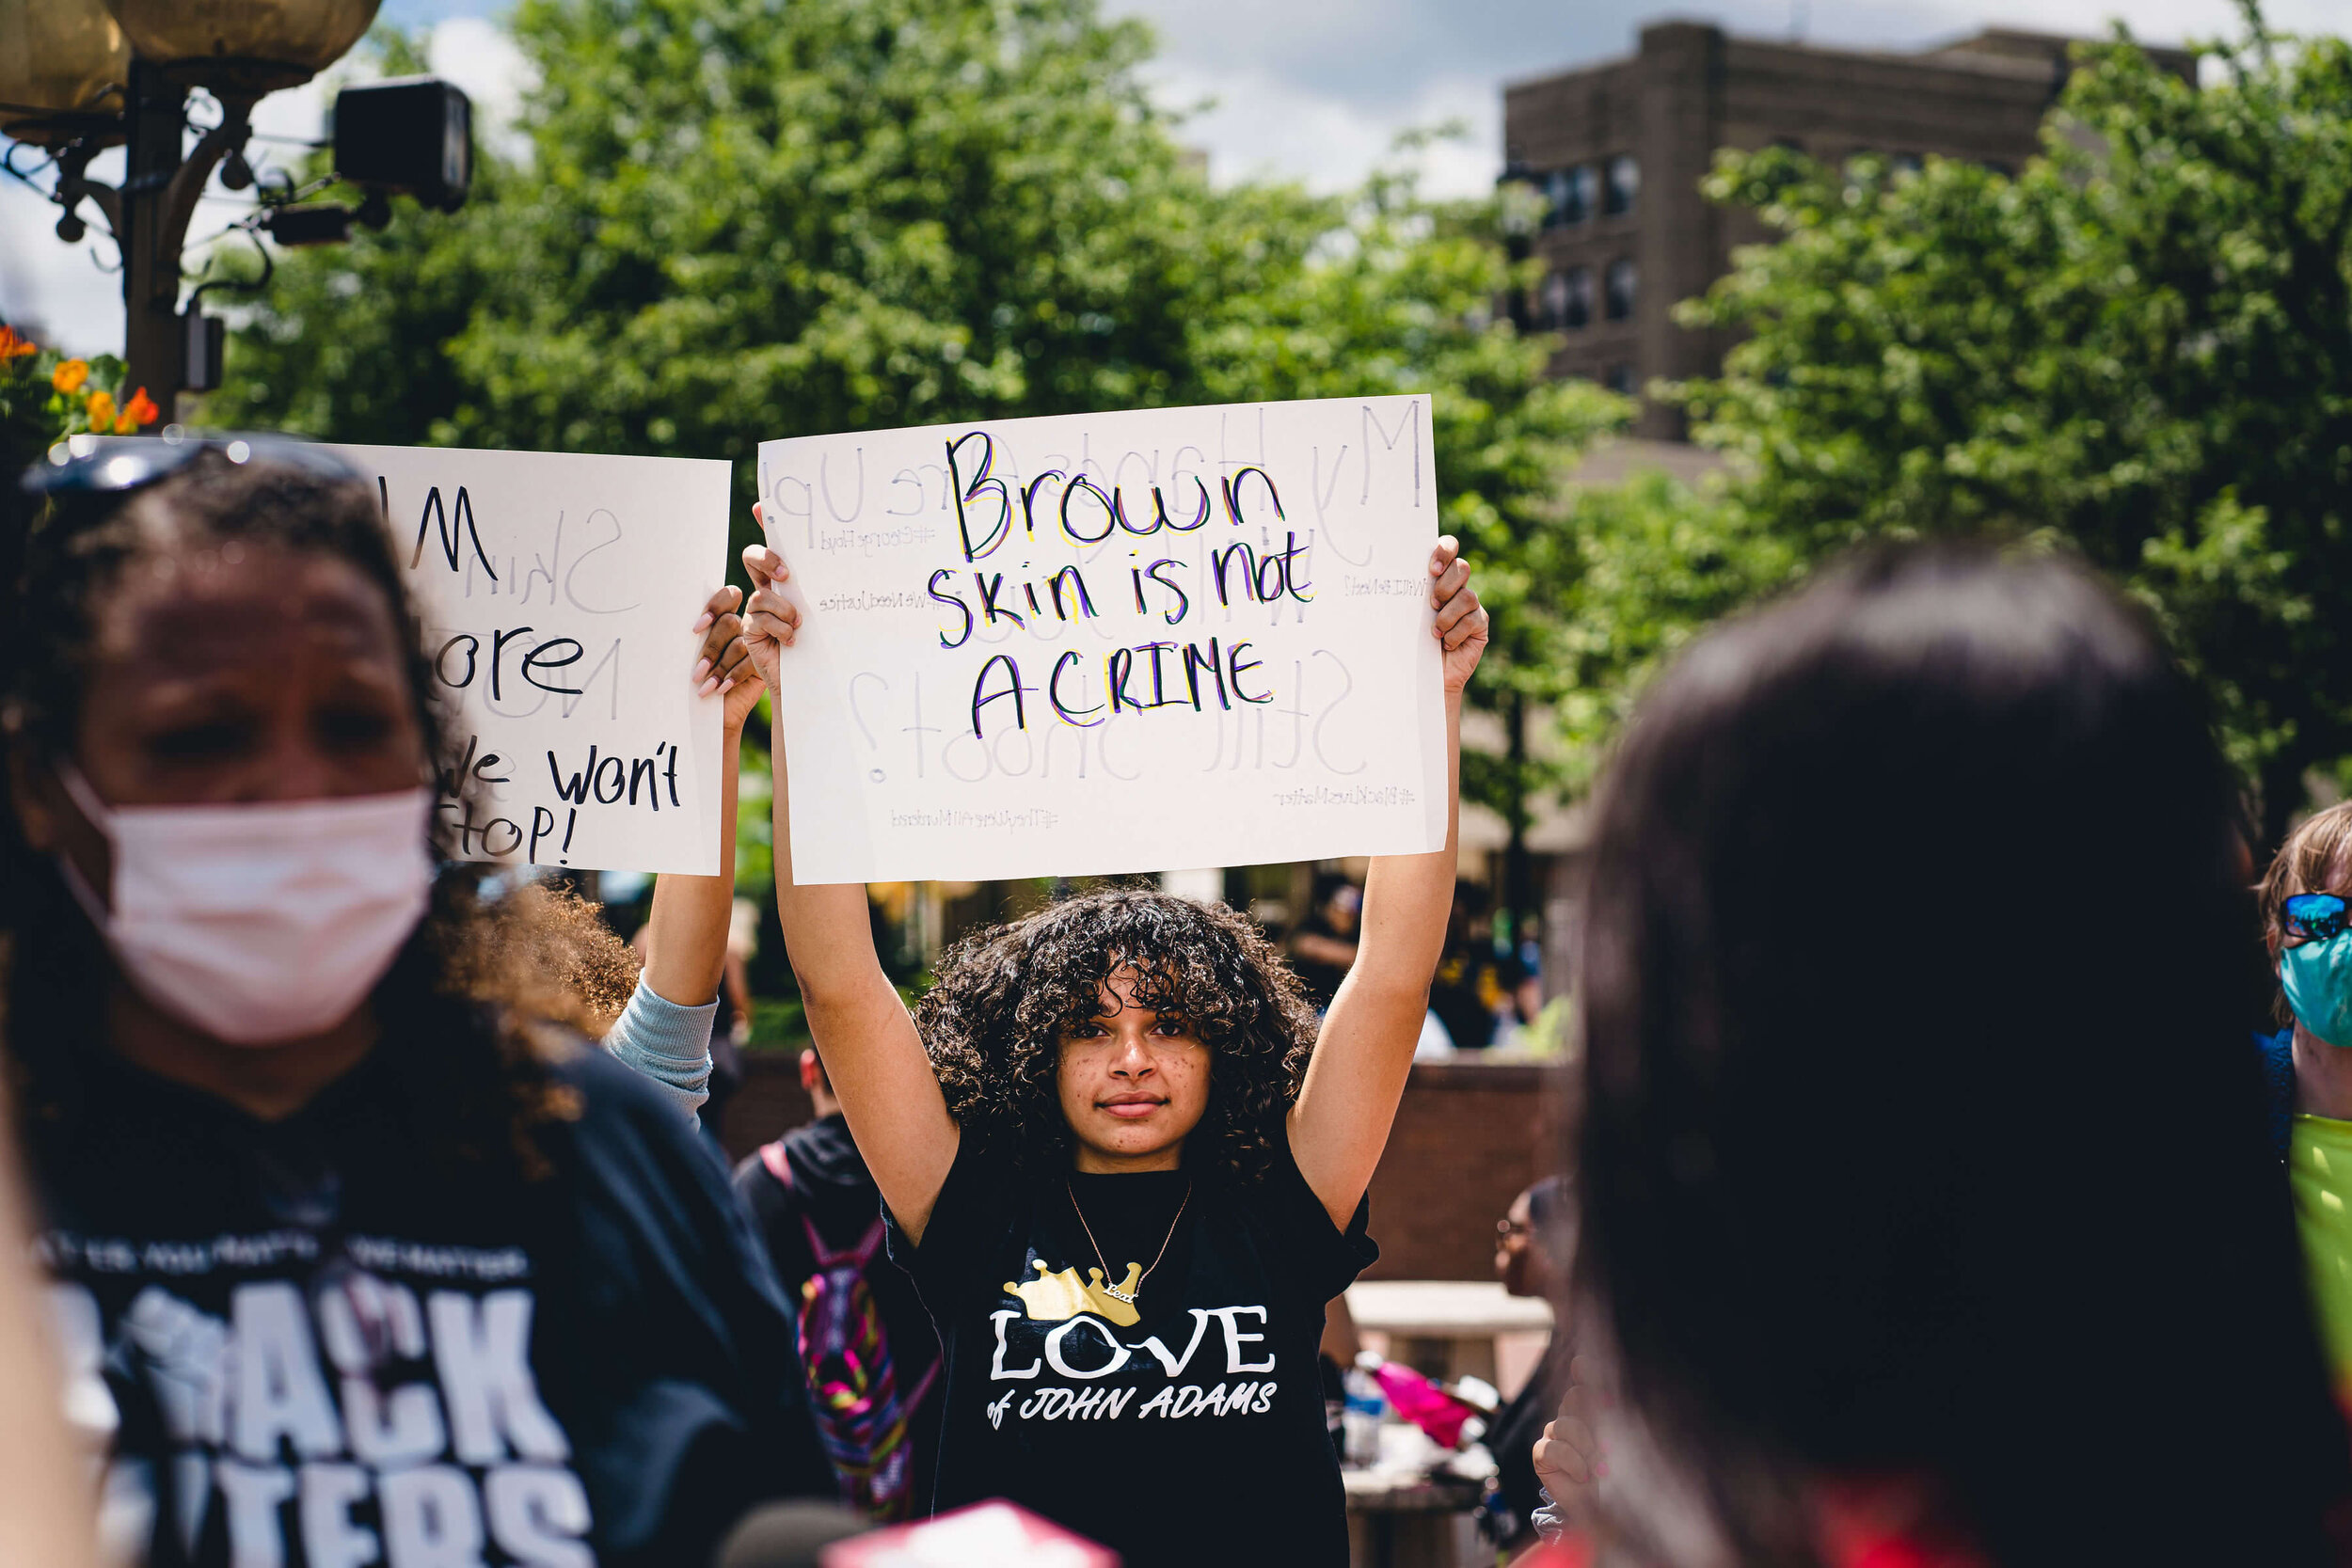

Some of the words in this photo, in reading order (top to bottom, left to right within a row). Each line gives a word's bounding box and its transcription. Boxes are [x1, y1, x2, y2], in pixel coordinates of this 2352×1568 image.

[945, 430, 1286, 563] Brown
[1128, 549, 1188, 625] is
[414, 616, 583, 701] ore
[971, 654, 1039, 740] A
[1049, 637, 1275, 728] CRIME
[433, 800, 577, 864] top!
[990, 1306, 1276, 1380] LOVE
[987, 1389, 1015, 1430] of
[1019, 1386, 1136, 1420] JOHN
[1138, 1381, 1277, 1418] ADAMS
